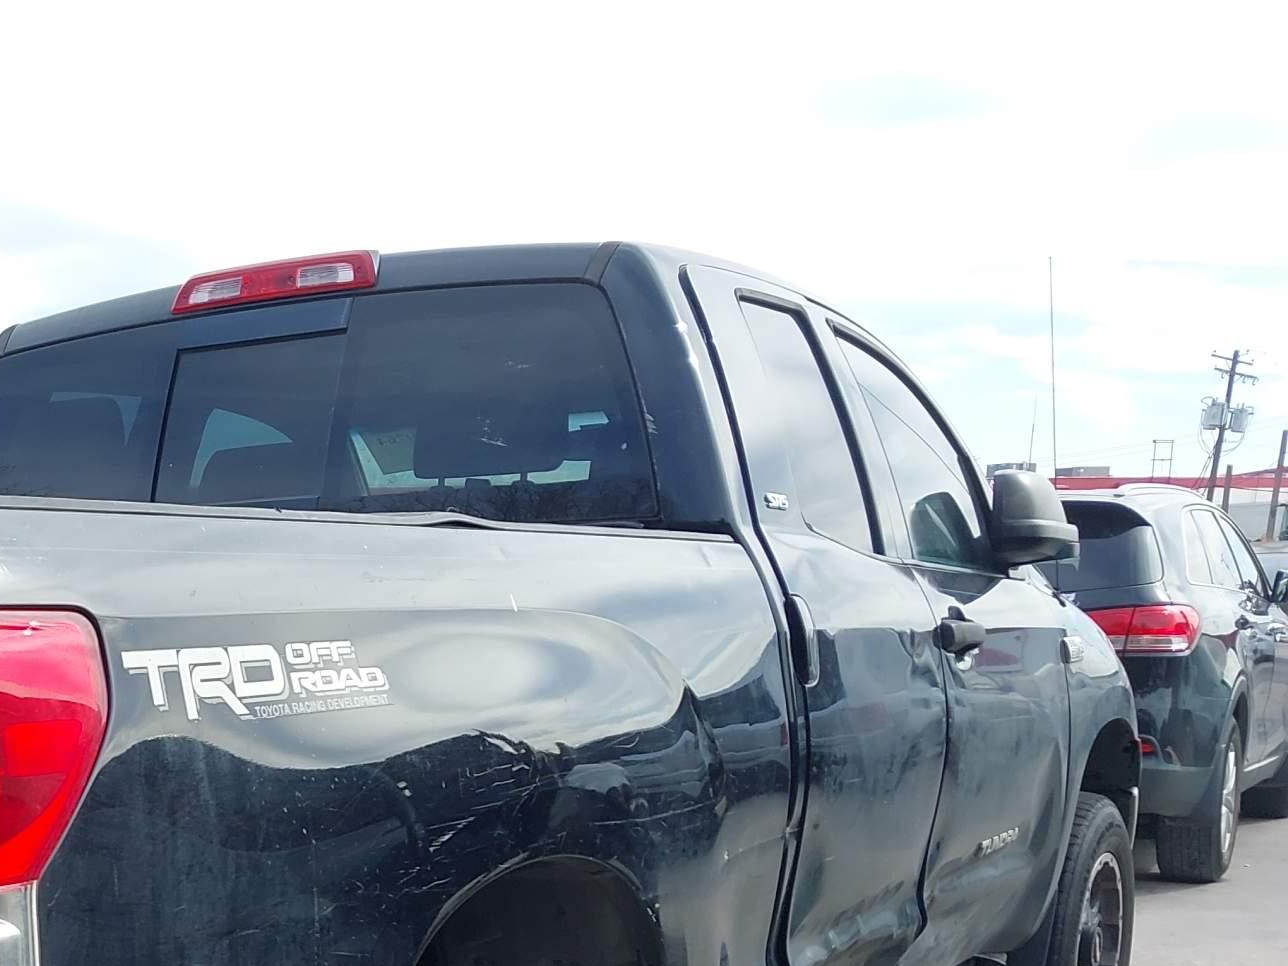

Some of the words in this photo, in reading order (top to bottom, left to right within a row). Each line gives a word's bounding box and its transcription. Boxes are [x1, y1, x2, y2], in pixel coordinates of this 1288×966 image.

[284, 639, 356, 667] OFF
[120, 644, 289, 721] TRD
[289, 666, 391, 697] ROAD
[255, 702, 291, 719] TOYOTA
[291, 699, 326, 715] RACING
[327, 693, 391, 712] DEVELOPMENT
